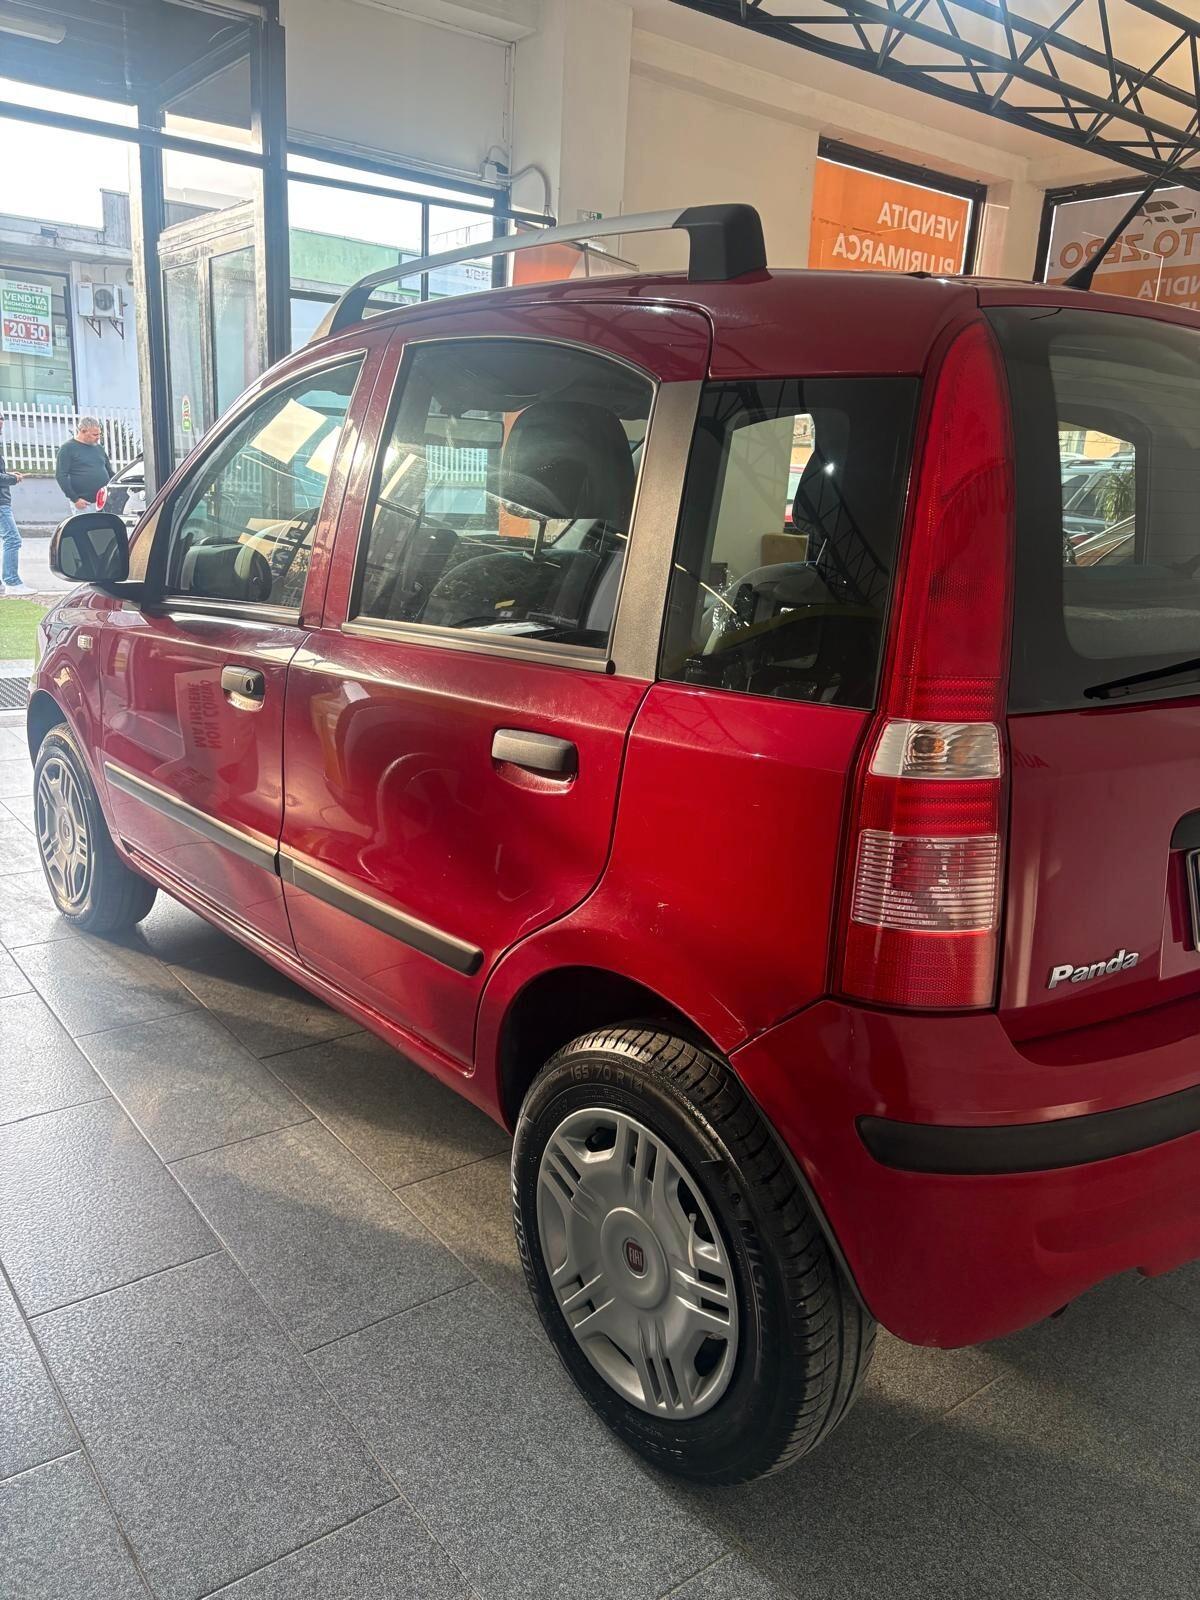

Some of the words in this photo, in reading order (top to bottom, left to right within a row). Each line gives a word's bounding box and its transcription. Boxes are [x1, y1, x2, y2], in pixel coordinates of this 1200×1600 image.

[3, 291, 48, 306] VENDITA
[13, 313, 39, 322] SCONTI
[1047, 949, 1139, 990] Panda
[628, 1246, 643, 1268] FIAT
